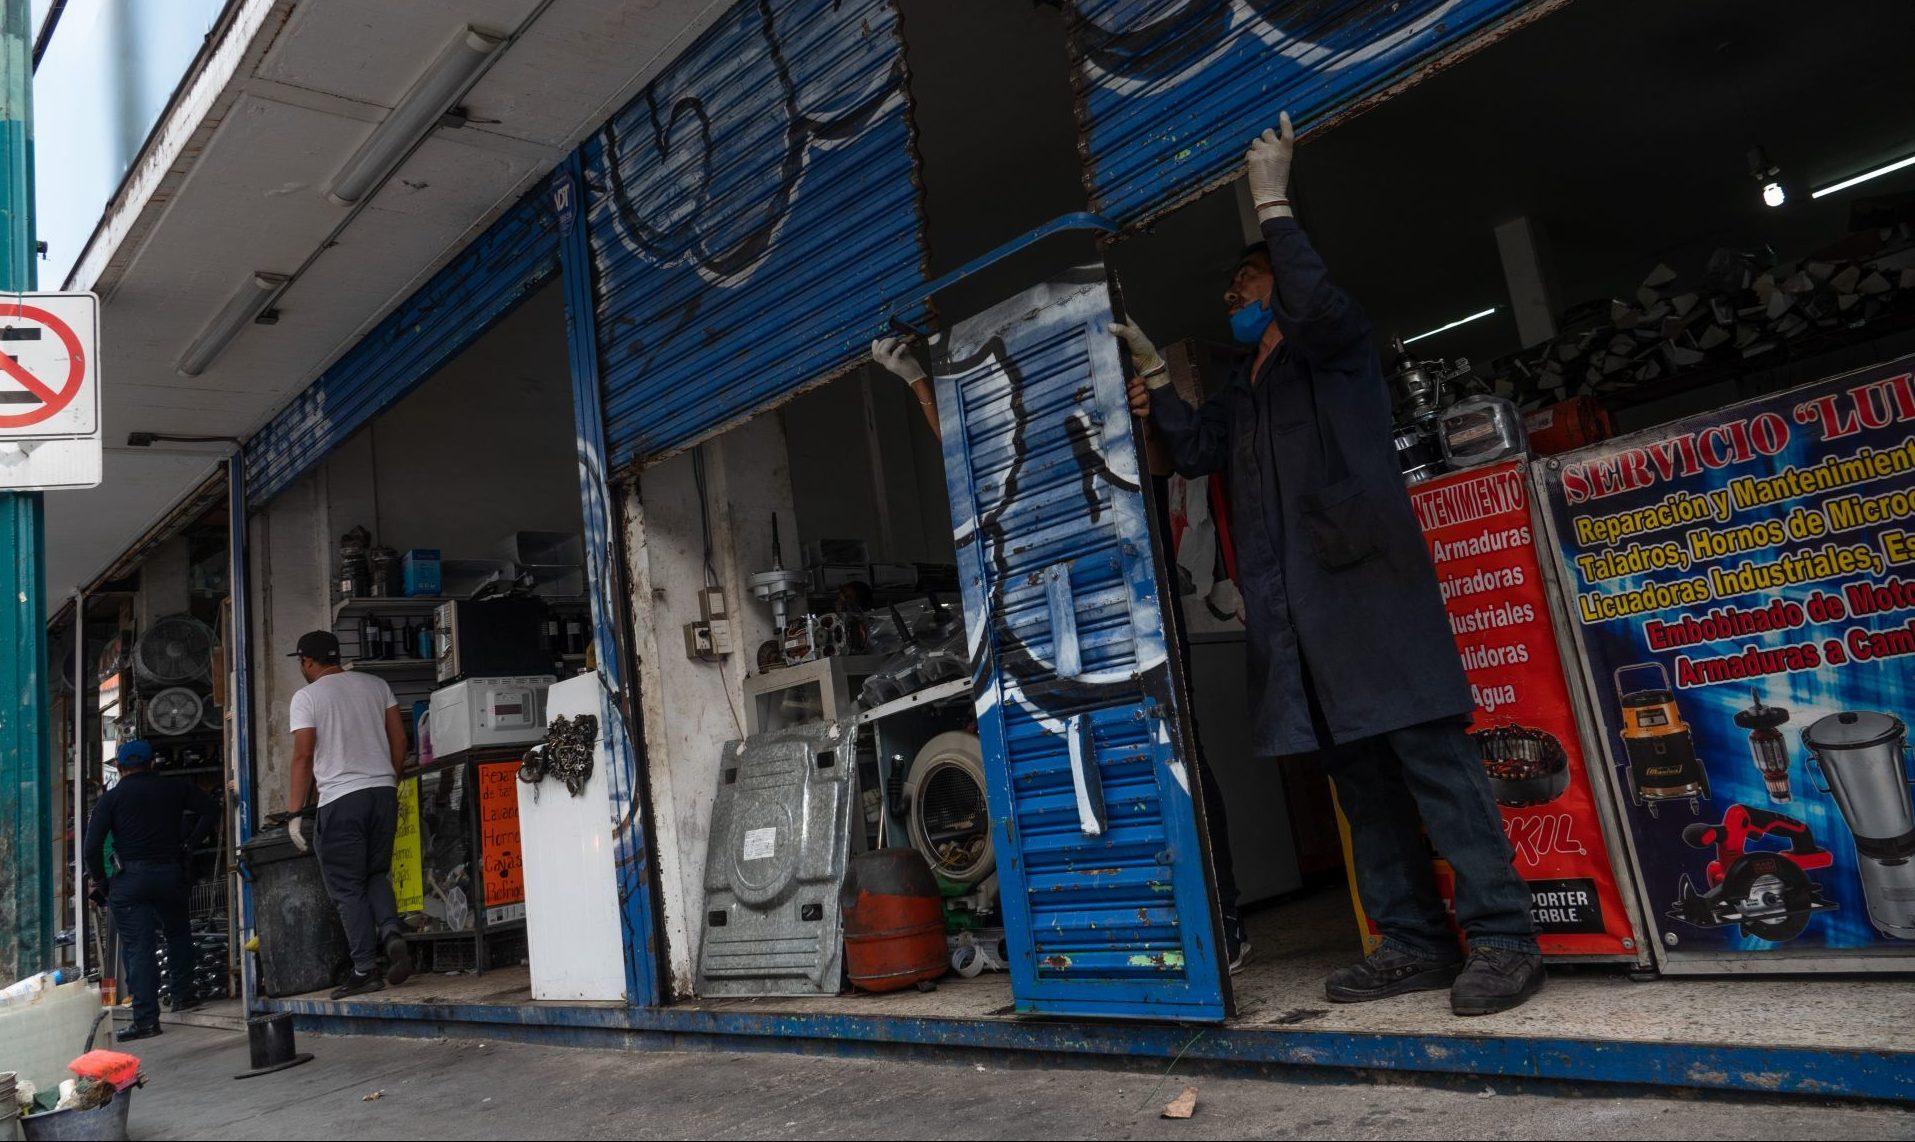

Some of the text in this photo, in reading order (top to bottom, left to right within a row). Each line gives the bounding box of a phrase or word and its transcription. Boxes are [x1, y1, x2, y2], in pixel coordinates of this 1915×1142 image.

[1561, 373, 1915, 506] SERVICIO “LUI
[1577, 494, 1709, 544] Reparación
[1711, 488, 1729, 521] y
[1433, 526, 1531, 564] Armaduras
[1578, 544, 1688, 583] Taladros,
[1690, 521, 1784, 559] Hornos
[1788, 508, 1826, 540] de
[1579, 577, 1710, 622] Licuadoras
[1711, 544, 1882, 597] Industriales,
[1645, 599, 1804, 650] Embobinado
[1806, 590, 1846, 622] de
[1677, 644, 1819, 687] Armaduras
[1824, 639, 1848, 665] a
[1470, 684, 1516, 712] Agua
[1503, 813, 1581, 867] KIL
[1532, 891, 1588, 907] ORTER
